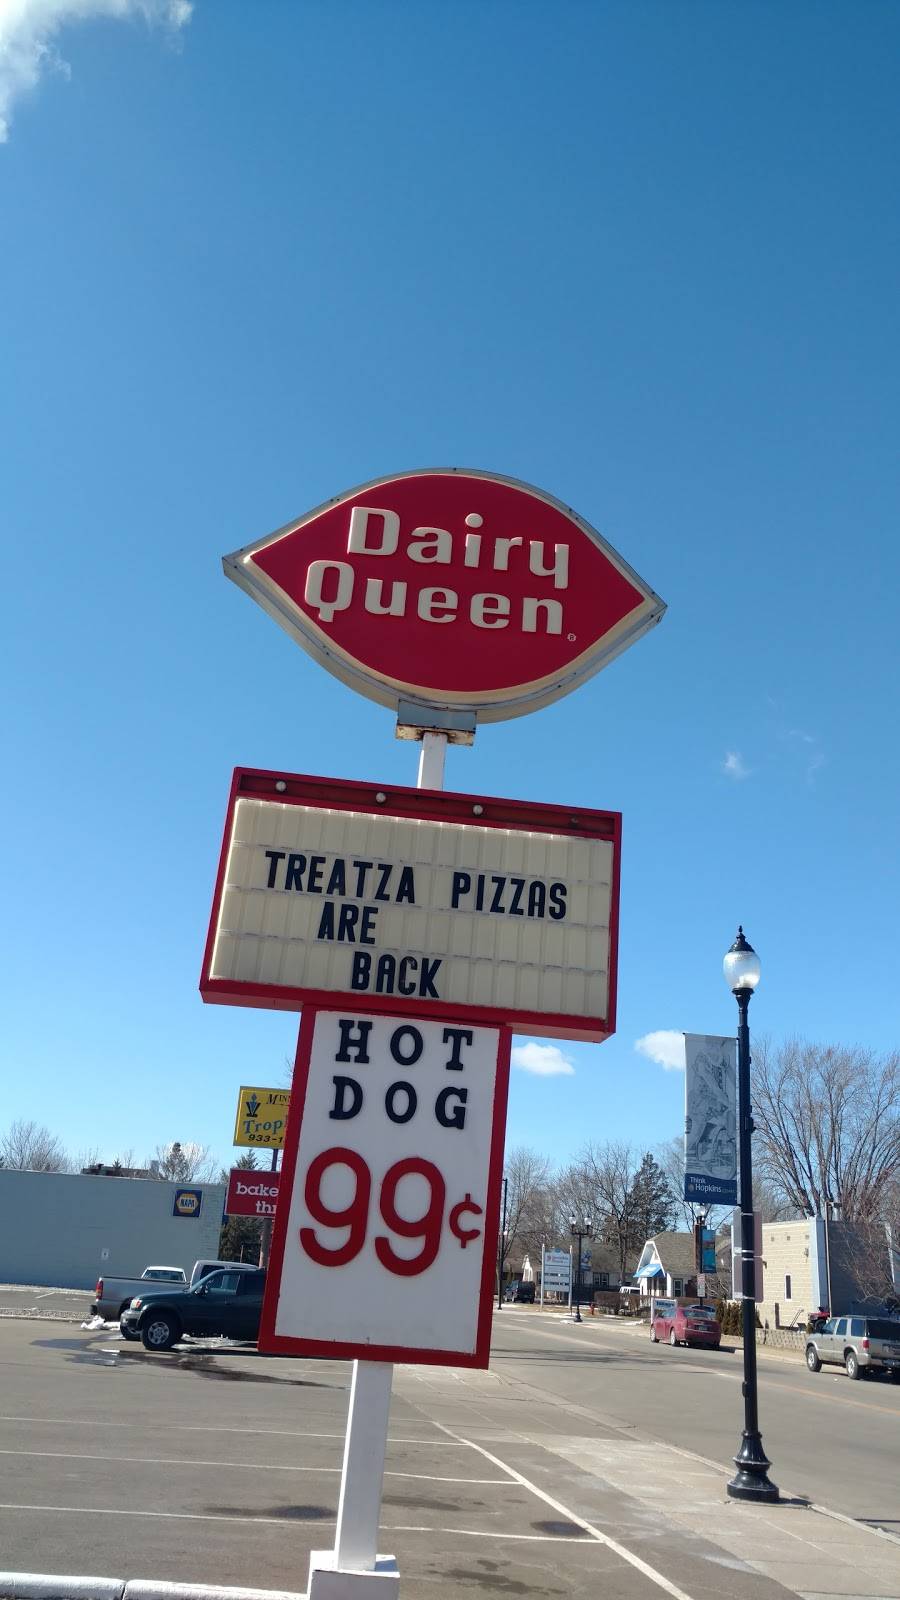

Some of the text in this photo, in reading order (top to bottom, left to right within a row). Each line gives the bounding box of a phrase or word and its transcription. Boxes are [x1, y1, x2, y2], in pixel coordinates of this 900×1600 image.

[347, 506, 569, 590] Dairy
[304, 560, 564, 634] Queen
[265, 850, 568, 920] TREATZA PIZZAS
[317, 901, 380, 945] ARE
[351, 951, 443, 998] BACK
[335, 1019, 473, 1071] HOT
[243, 1117, 287, 1134] Trop
[329, 1075, 468, 1130] DOG
[236, 1182, 280, 1197] bake
[300, 1146, 483, 1277] 99¢
[695, 1183, 722, 1193] Hopkins
